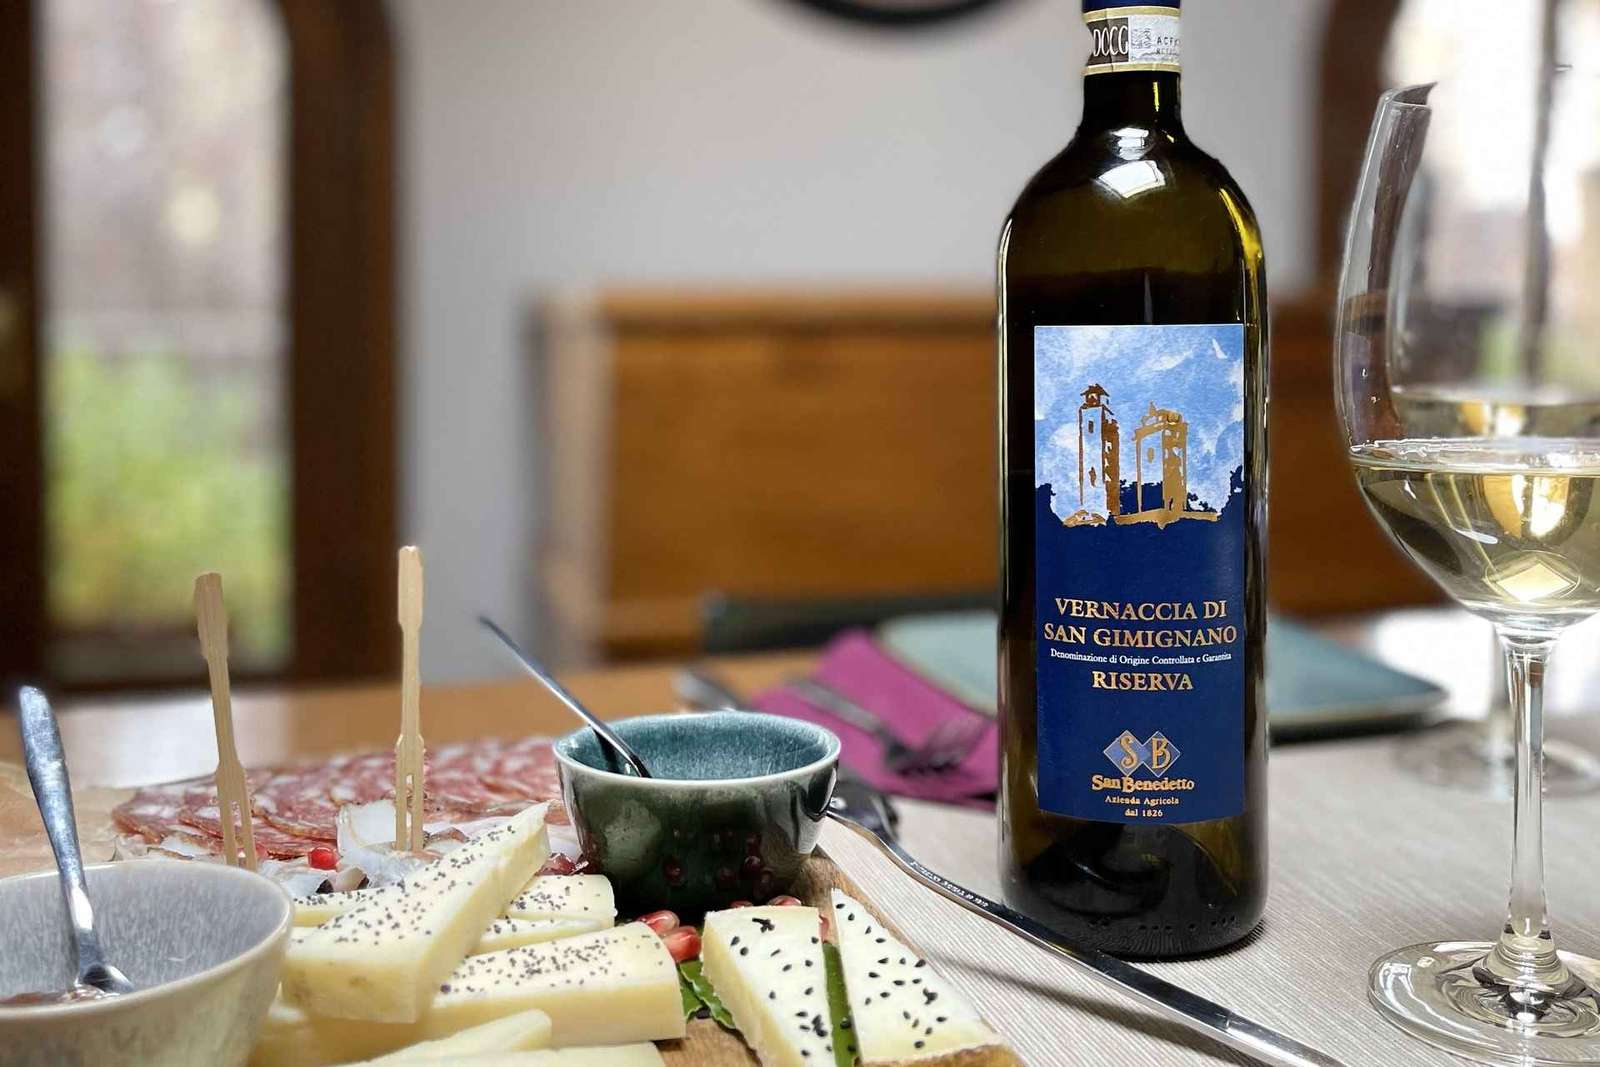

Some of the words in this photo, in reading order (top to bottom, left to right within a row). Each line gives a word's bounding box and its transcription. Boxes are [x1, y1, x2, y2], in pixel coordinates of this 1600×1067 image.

[1093, 25, 1128, 57] DOCG
[1055, 597, 1198, 621] VERNACCIA
[1203, 600, 1227, 619] DI
[1044, 623, 1087, 645] SAN
[1093, 625, 1237, 648] GIMIGNANO
[1050, 648, 1108, 663] Denominazione
[1109, 654, 1118, 664] di
[1119, 654, 1150, 667] Origine
[1151, 655, 1195, 665] Controllata
[1202, 651, 1232, 663] Garantita
[1092, 670, 1194, 691] RISERVA
[1105, 795, 1140, 805] Azienda
[1143, 796, 1180, 807] Agricola
[1124, 808, 1139, 817] dal
[1142, 809, 1163, 817] 1826
